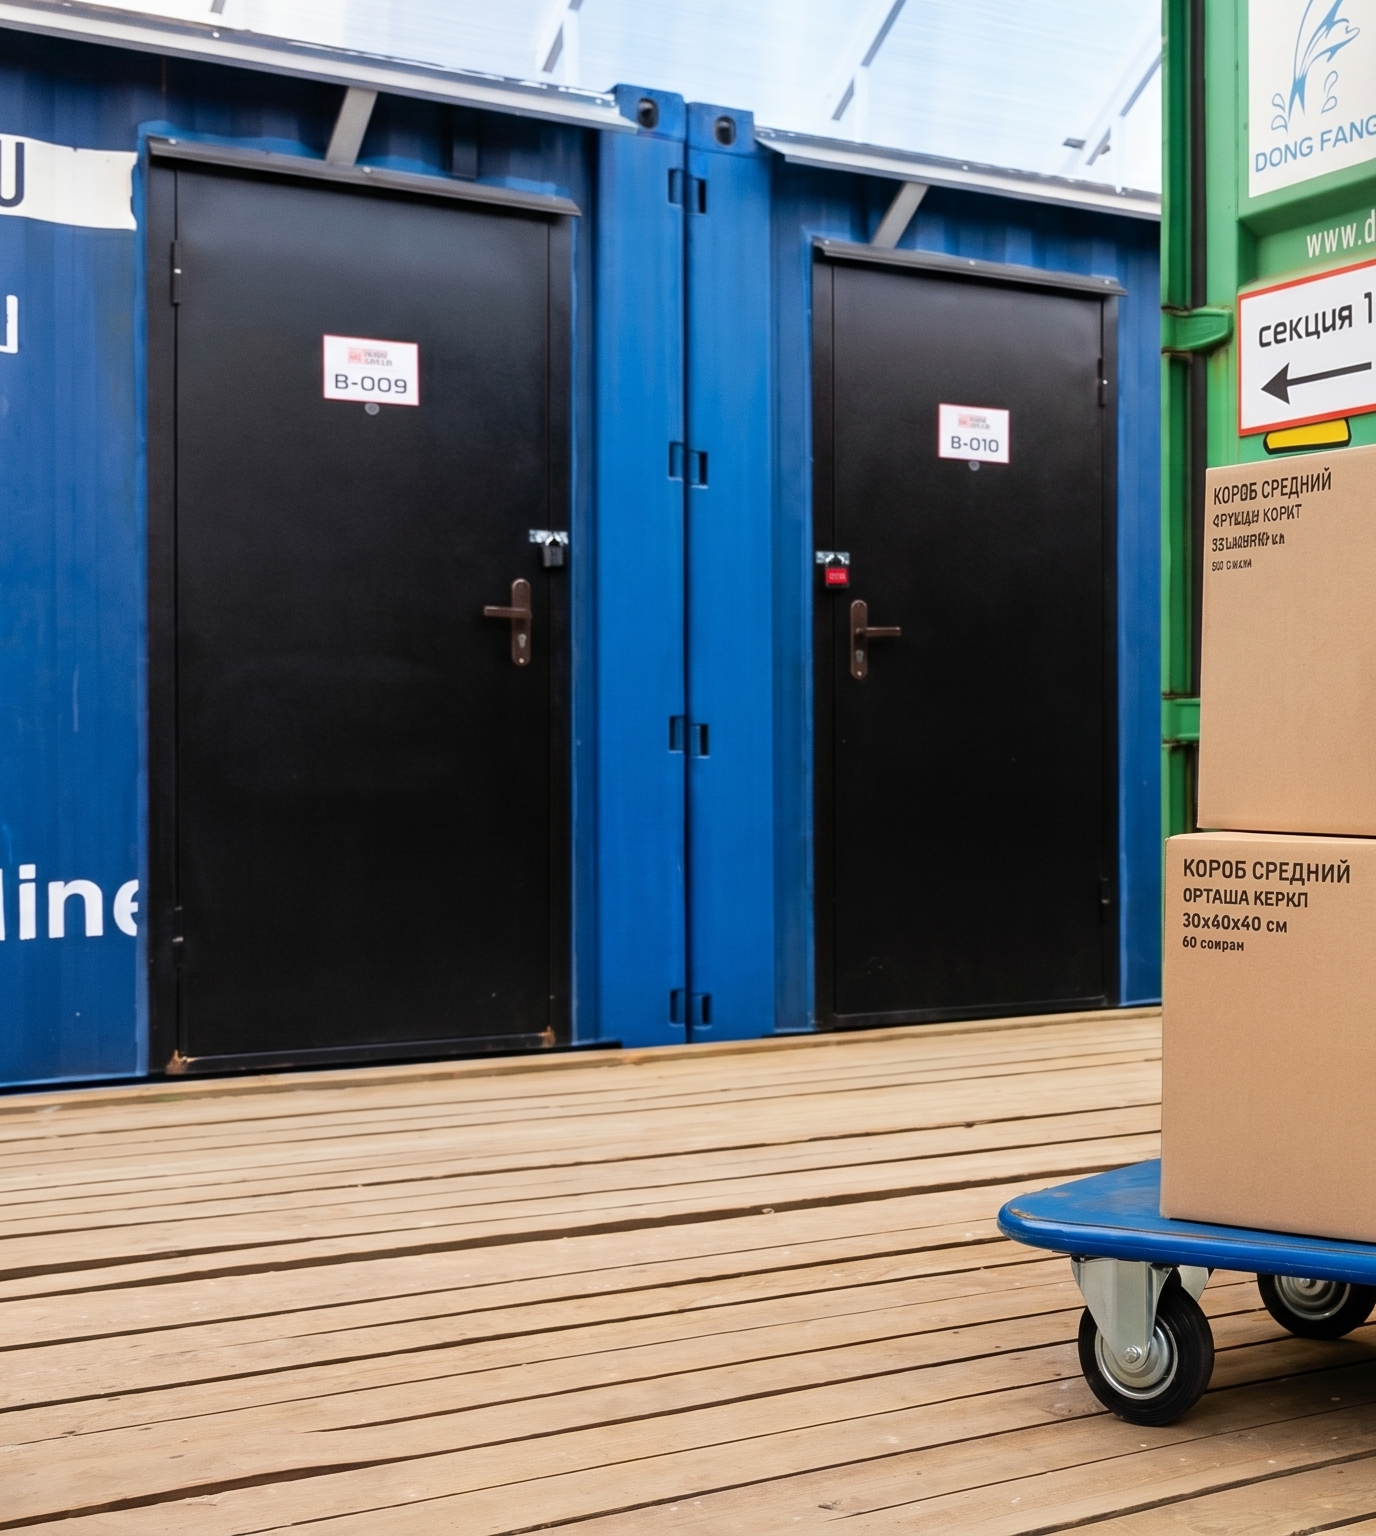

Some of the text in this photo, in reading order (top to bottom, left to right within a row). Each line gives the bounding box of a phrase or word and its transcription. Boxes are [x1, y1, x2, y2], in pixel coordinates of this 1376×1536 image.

[1255, 136, 1314, 173] DONG
[1259, 291, 1373, 348] секция 1
[335, 373, 407, 394] B-009
[951, 435, 999, 453] B-010
[1213, 467, 1332, 506] КОРОБ СРЕДНИЙ
[1183, 858, 1351, 886] КОРОБ СРЕДНИЙ
[1183, 887, 1309, 908] ОРТАША КЕРКЛ
[1182, 936, 1197, 948] 60
